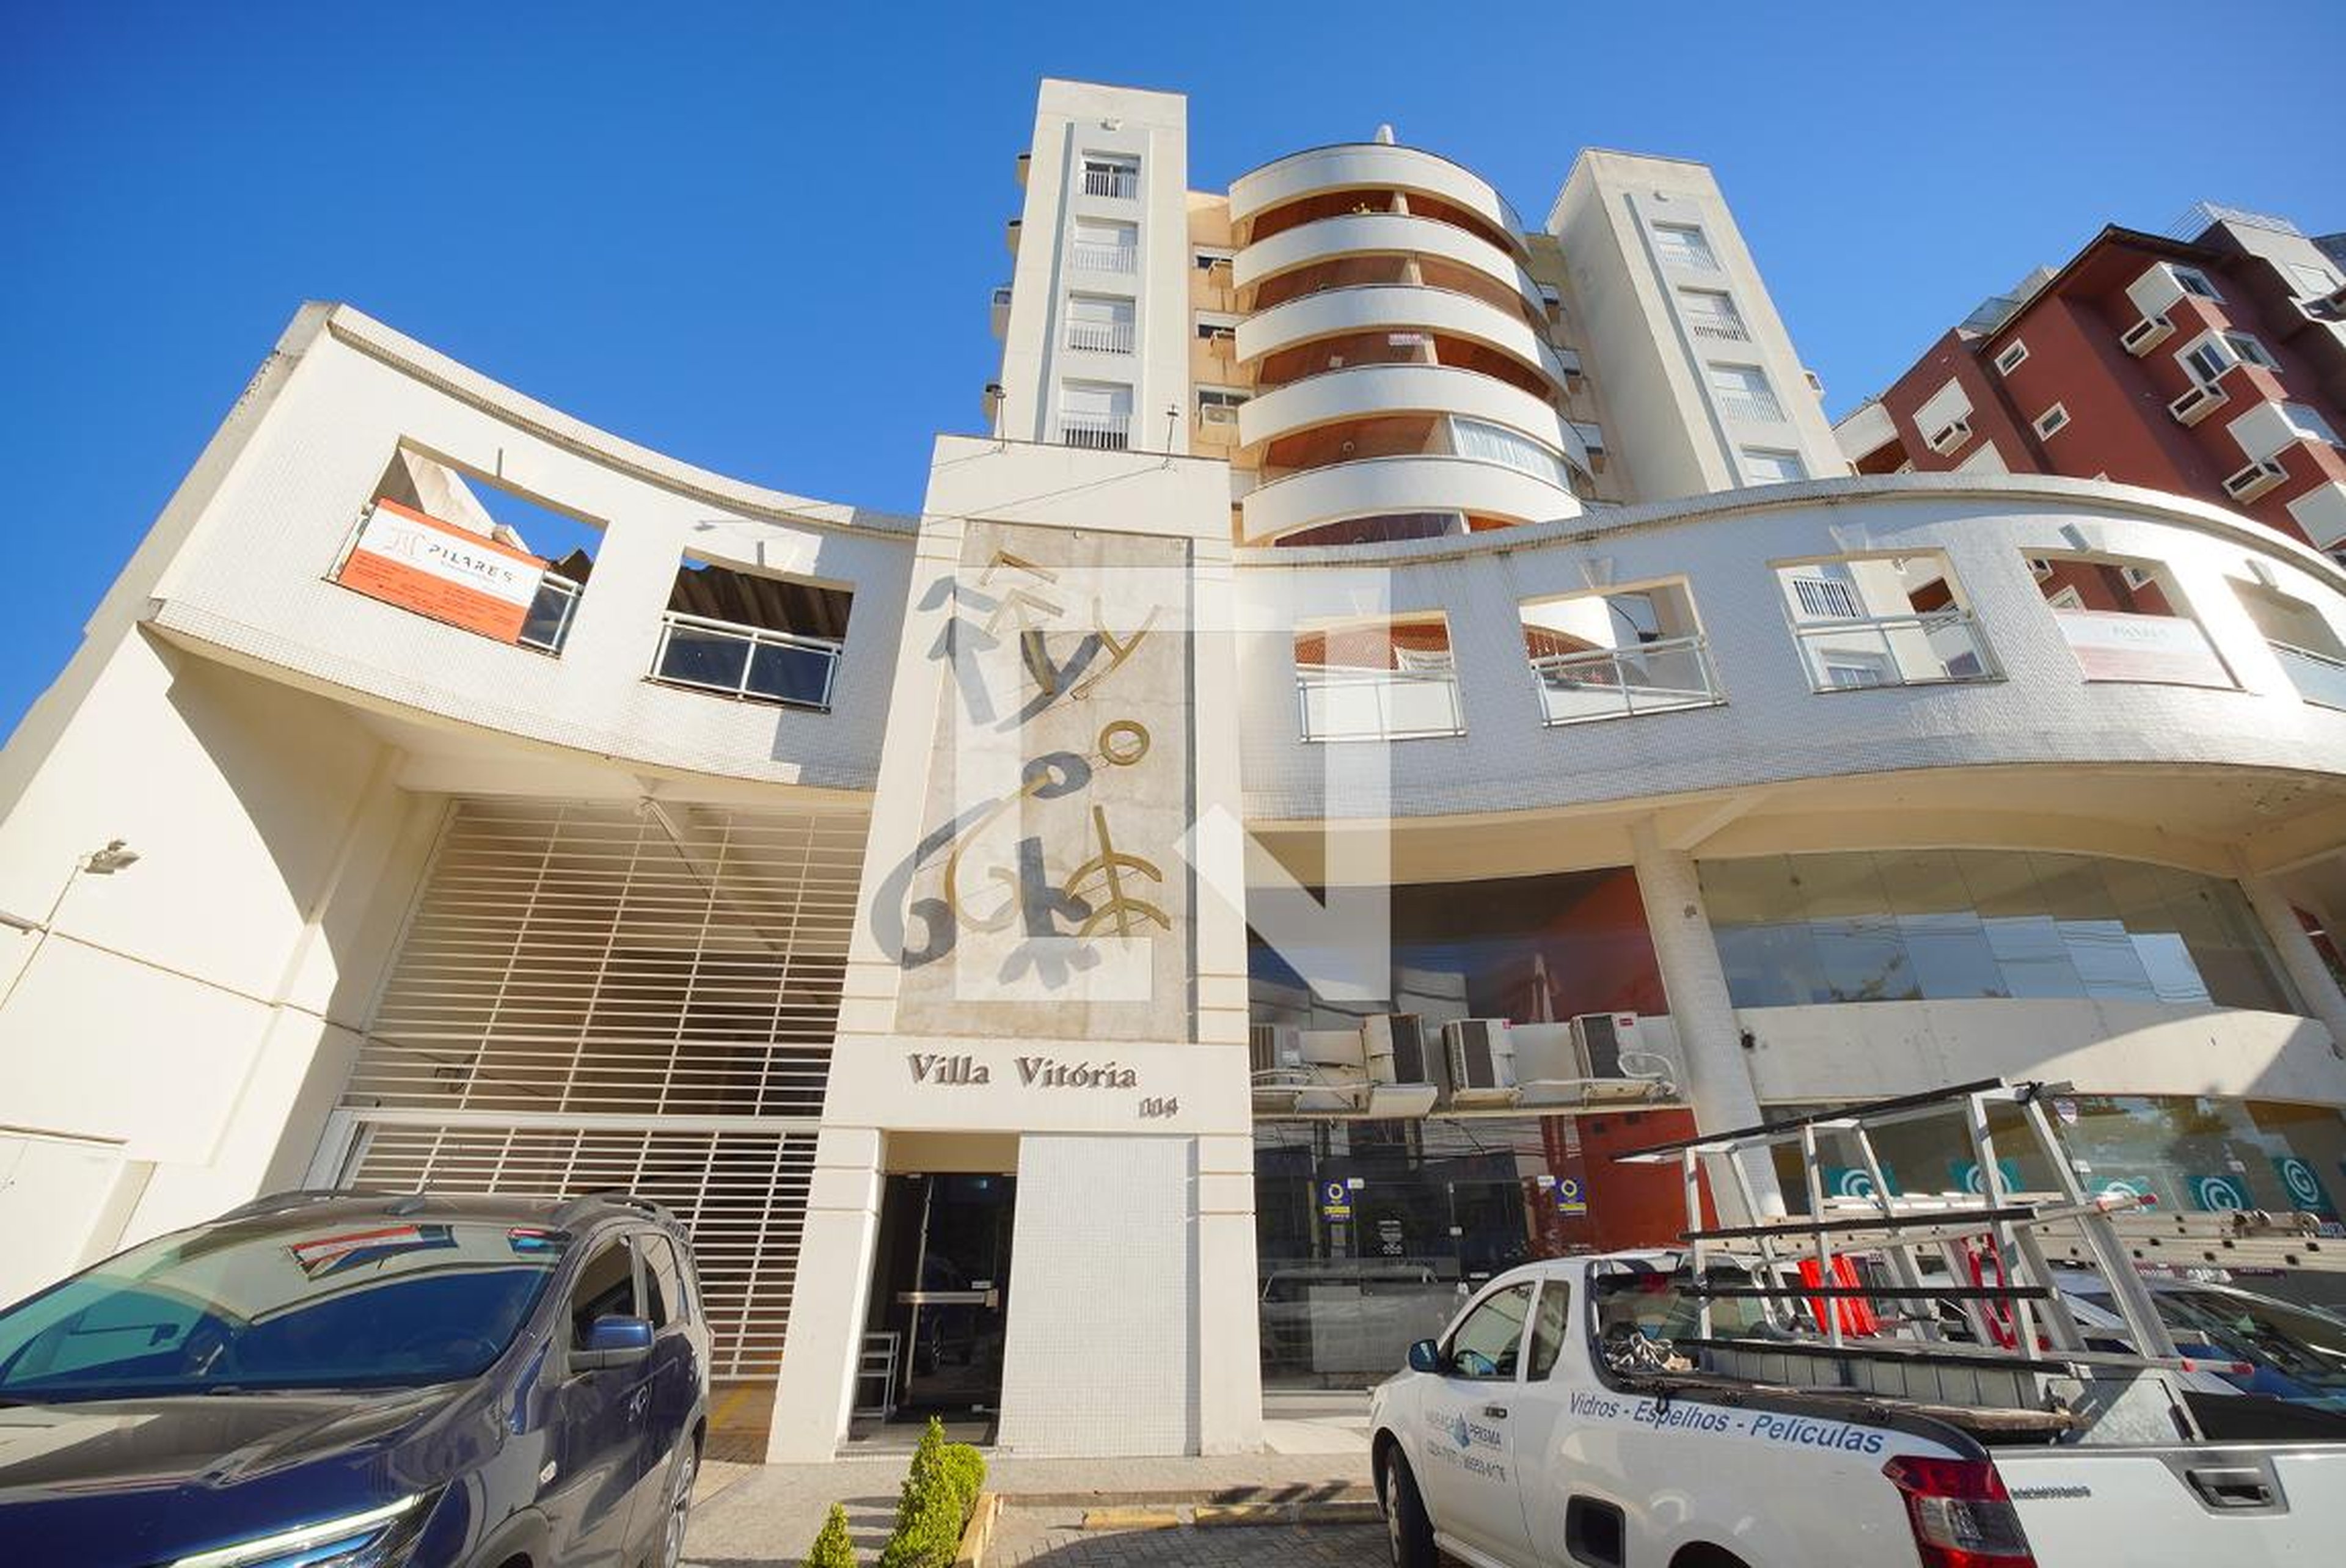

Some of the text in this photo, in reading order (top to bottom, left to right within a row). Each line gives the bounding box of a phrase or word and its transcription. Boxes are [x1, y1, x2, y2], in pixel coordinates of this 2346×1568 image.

[428, 544, 513, 582] PILARES
[907, 1053, 1137, 1088] Villa Vitória
[1569, 1392, 1620, 1417] Vidros
[1633, 1401, 1730, 1431] Espelhos
[1750, 1414, 1884, 1454] Películas
